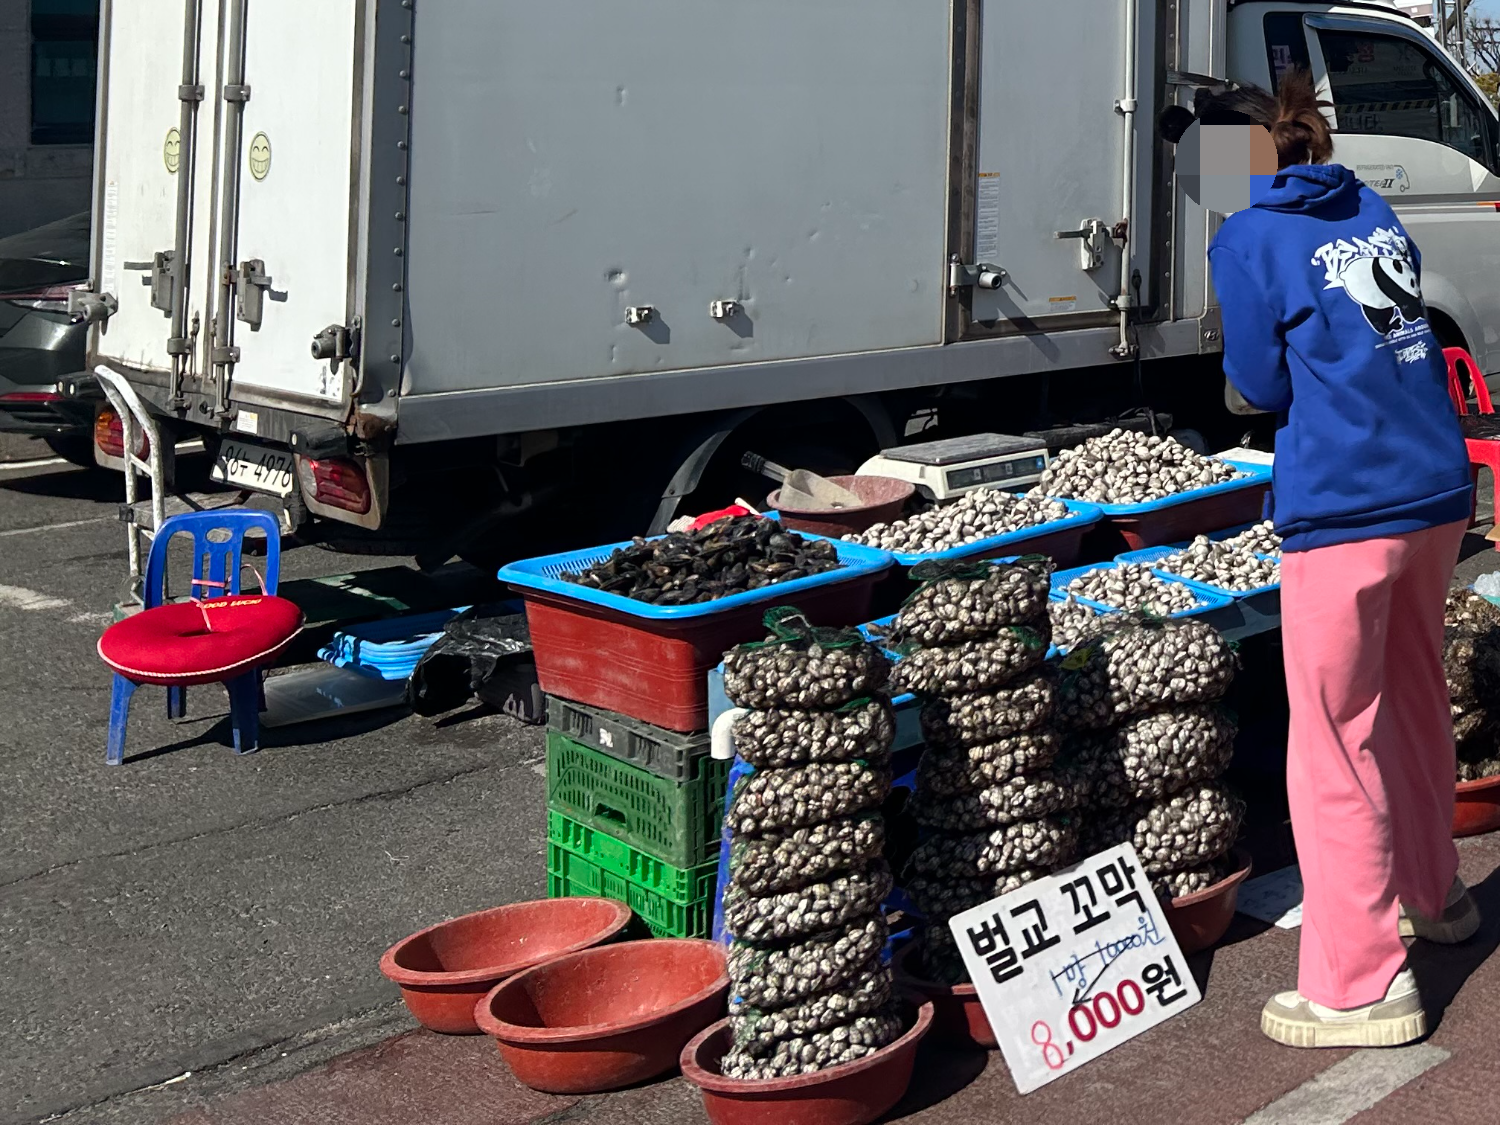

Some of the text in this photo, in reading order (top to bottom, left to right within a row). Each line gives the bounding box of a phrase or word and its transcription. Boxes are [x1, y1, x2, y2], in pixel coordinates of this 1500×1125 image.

[254, 453, 292, 488] 4976
[966, 856, 1147, 985] 벌교 꼬막
[1031, 954, 1188, 1071] 8,000원
